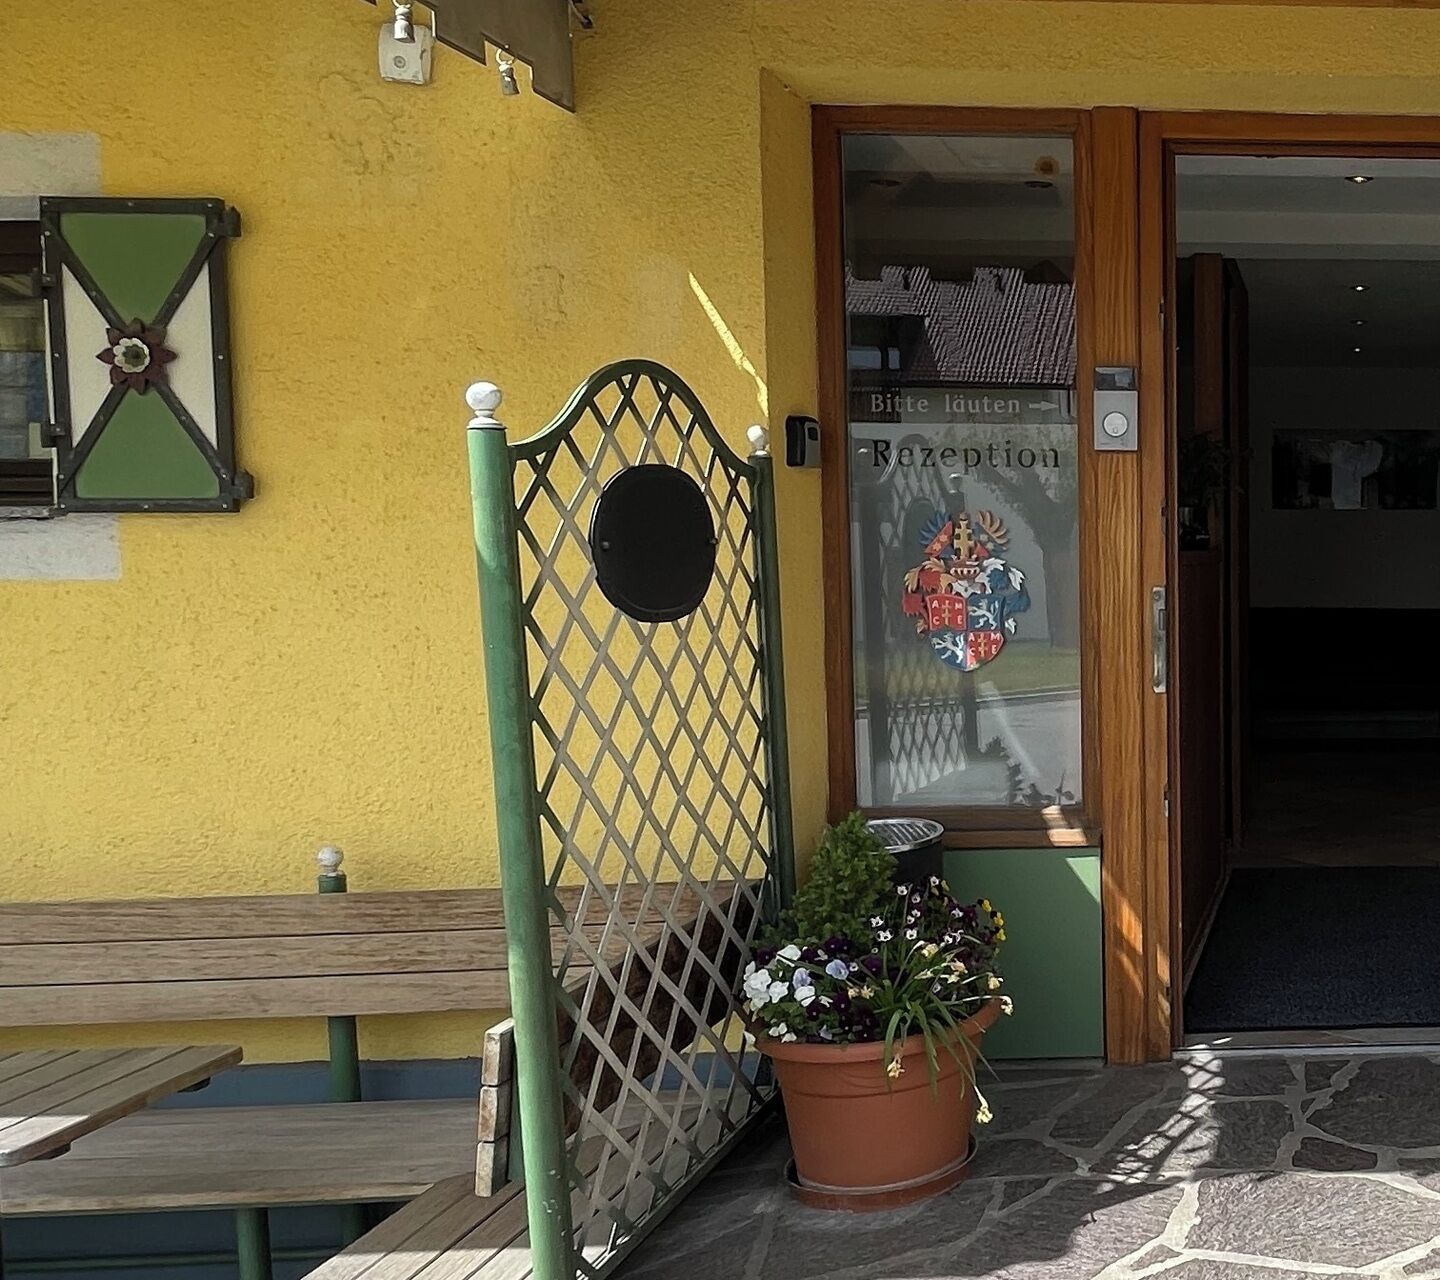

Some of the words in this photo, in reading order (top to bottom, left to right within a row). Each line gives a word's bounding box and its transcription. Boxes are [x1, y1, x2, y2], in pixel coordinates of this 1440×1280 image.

[870, 394, 930, 413] Bitte
[944, 393, 1021, 413] läuten
[872, 439, 1061, 474] Rezeption
